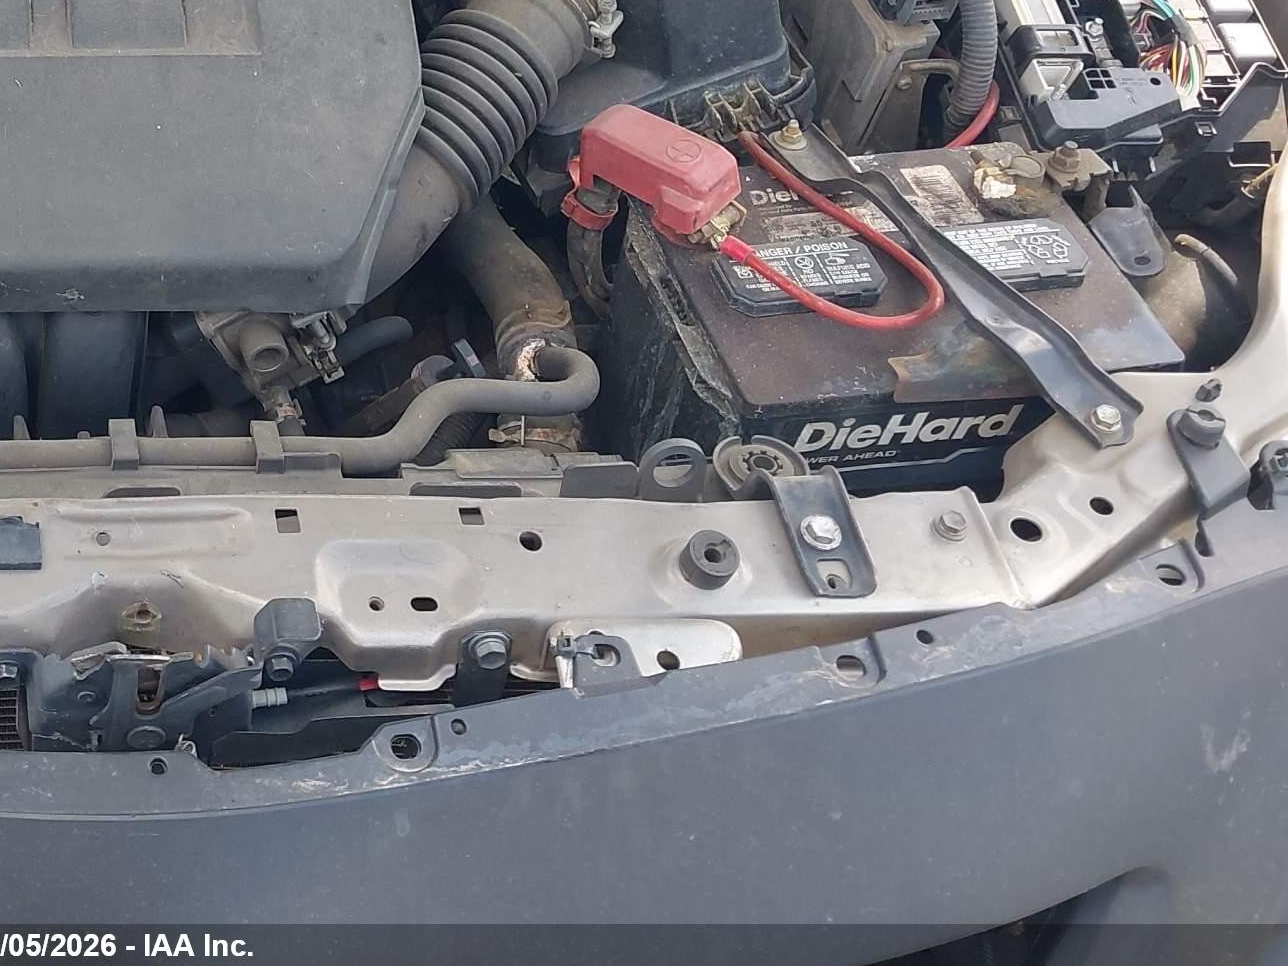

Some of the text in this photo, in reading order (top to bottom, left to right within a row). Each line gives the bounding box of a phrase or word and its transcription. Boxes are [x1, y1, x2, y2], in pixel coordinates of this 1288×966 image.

[804, 241, 848, 253] POISON
[794, 404, 1025, 452] DieHard
[807, 450, 897, 464] WER AHEAD
